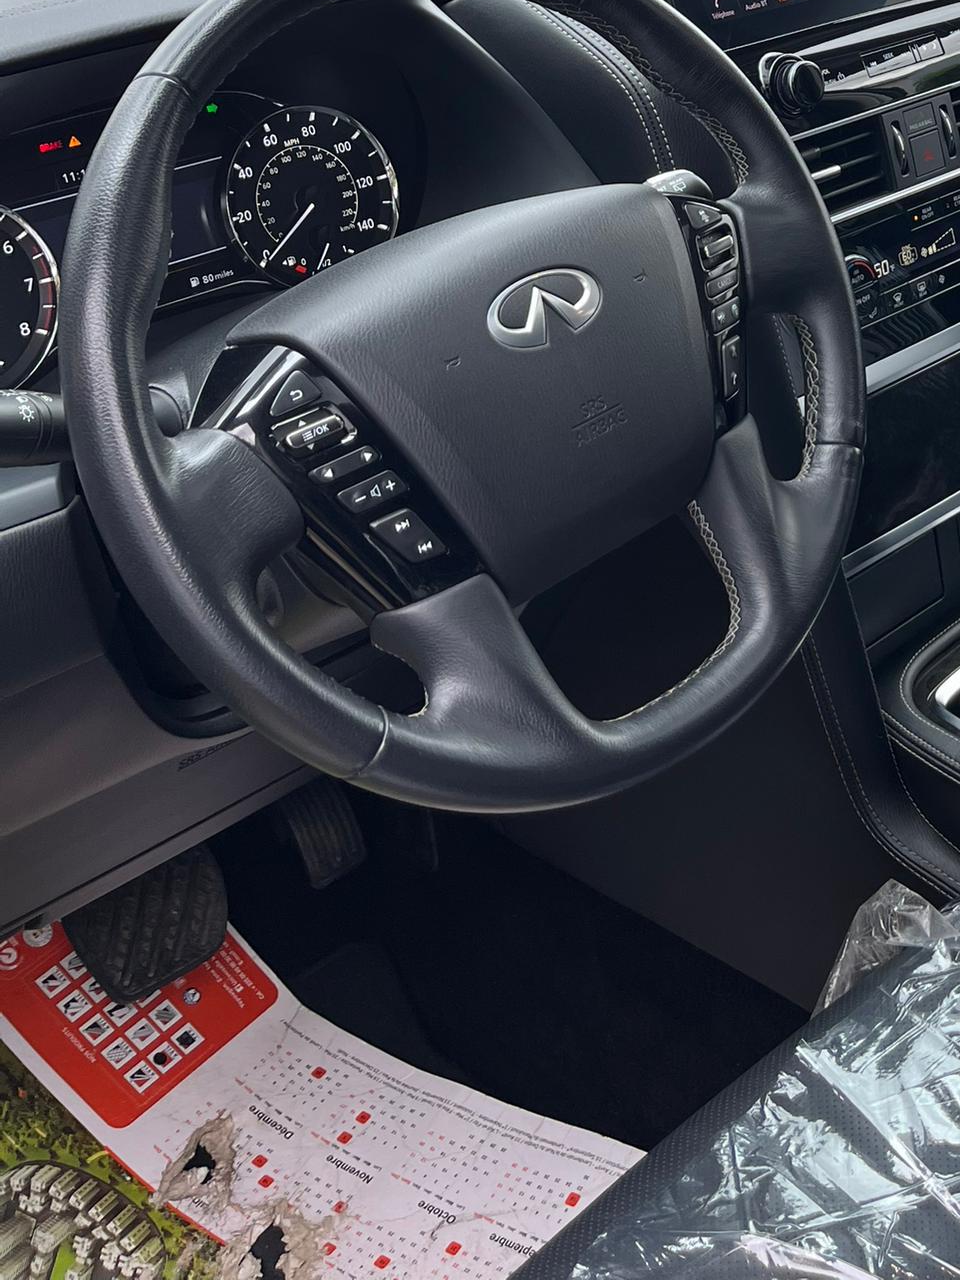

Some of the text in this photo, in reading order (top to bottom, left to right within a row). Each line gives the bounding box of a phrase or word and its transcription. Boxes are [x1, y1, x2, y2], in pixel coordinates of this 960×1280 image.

[301, 125, 316, 137] 80
[39, 140, 63, 153] BRAKE
[263, 134, 278, 147] 60
[283, 138, 300, 148] MPH
[333, 140, 352, 154] 100
[281, 155, 292, 163] 100
[296, 150, 307, 159] 120
[312, 153, 323, 162] 140
[269, 167, 279, 175] 80
[325, 161, 337, 169] 160
[62, 169, 86, 183] 11:1
[238, 167, 253, 179] 40
[336, 174, 347, 182] 180
[262, 182, 271, 190] 60
[356, 176, 374, 189] 120
[342, 190, 353, 198] 200
[238, 210, 252, 223] 20
[342, 208, 353, 217] 220
[267, 217, 276, 225] 20
[357, 218, 375, 232] 140
[2, 241, 14, 254] 6
[301, 258, 307, 266] 0
[202, 270, 234, 284] 80 miles
[24, 278, 34, 292] 7
[19, 322, 31, 337] 8
[581, 395, 607, 420] SRS
[576, 407, 628, 448] AIRBAG
[246, 1103, 294, 1140] Décembre
[324, 1152, 373, 1184] Novembre
[416, 1197, 456, 1225] Octobre
[488, 1229, 536, 1260] eptembre
